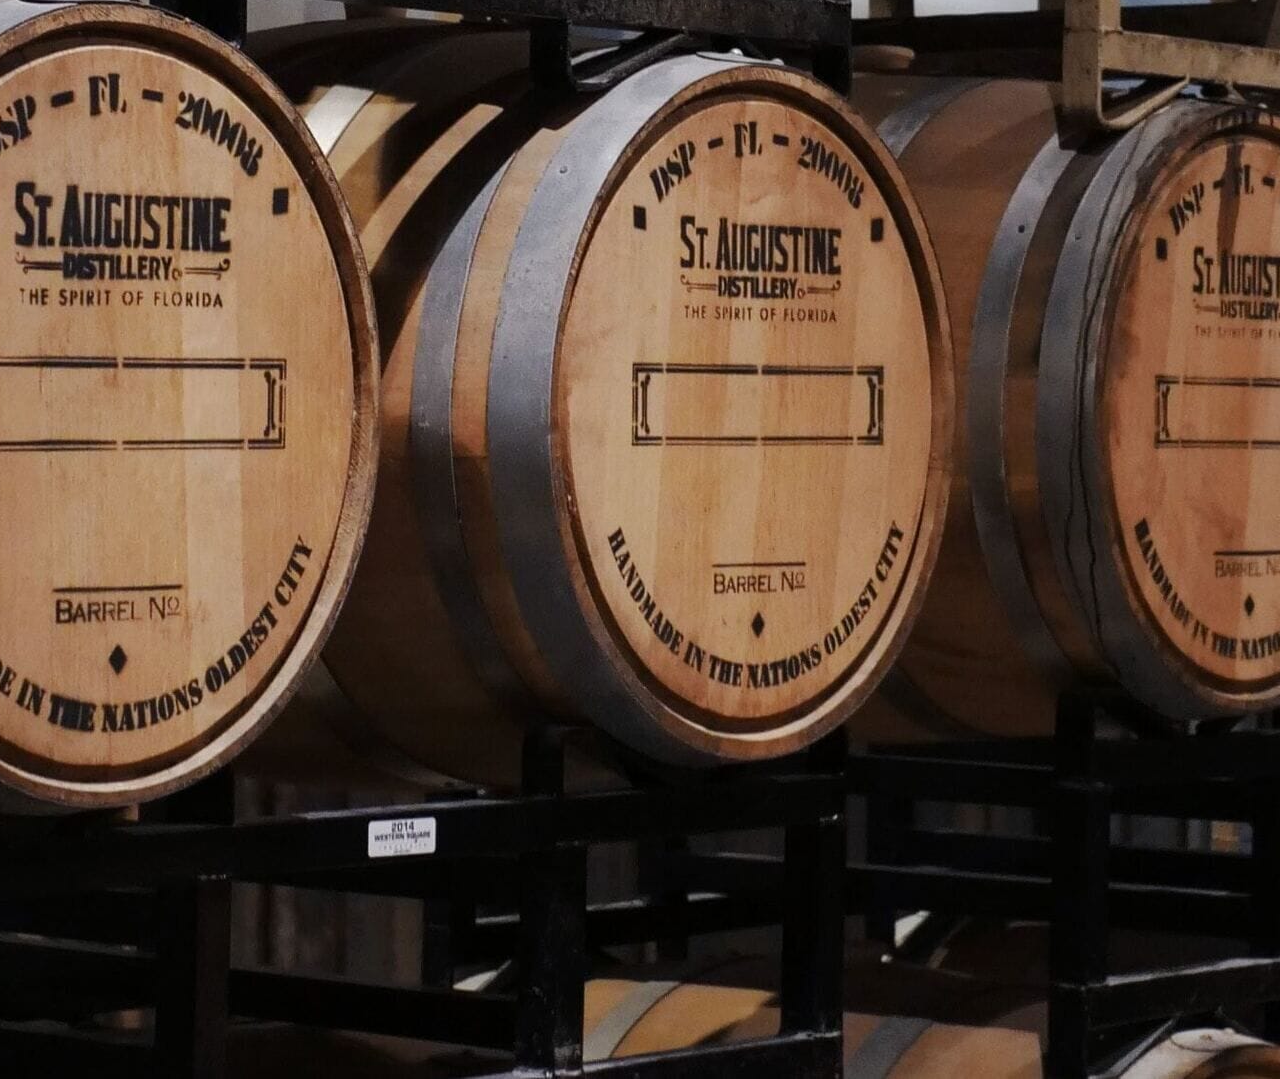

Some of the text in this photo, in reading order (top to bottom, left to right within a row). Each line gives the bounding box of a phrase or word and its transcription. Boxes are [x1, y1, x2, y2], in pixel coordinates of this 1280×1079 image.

[88, 72, 128, 118] FL
[650, 140, 696, 202] DSP
[734, 120, 763, 159] FL
[62, 185, 232, 254] AUGUSTINE
[715, 217, 841, 276] AUGUSTINE
[62, 254, 172, 280] DISTILLERY
[20, 288, 224, 308] THE SPIRIT OF FLORIDA
[715, 276, 797, 299] DISTILLERY
[684, 305, 836, 323] THE SPIRIT OF FLORIDA
[1217, 300, 1280, 321] DISTILLERY
[711, 572, 775, 595] BARREL
[54, 598, 140, 624] BARREL
[607, 520, 904, 689] HANDMADE IN THE NATIONS OLDEST CITY
[16, 678, 46, 716] IN
[48, 692, 96, 734] THE
[102, 678, 204, 732] NATIONS
[204, 602, 278, 692] OLDEST
[274, 536, 312, 606] CITY
[391, 821, 414, 832] 2014
